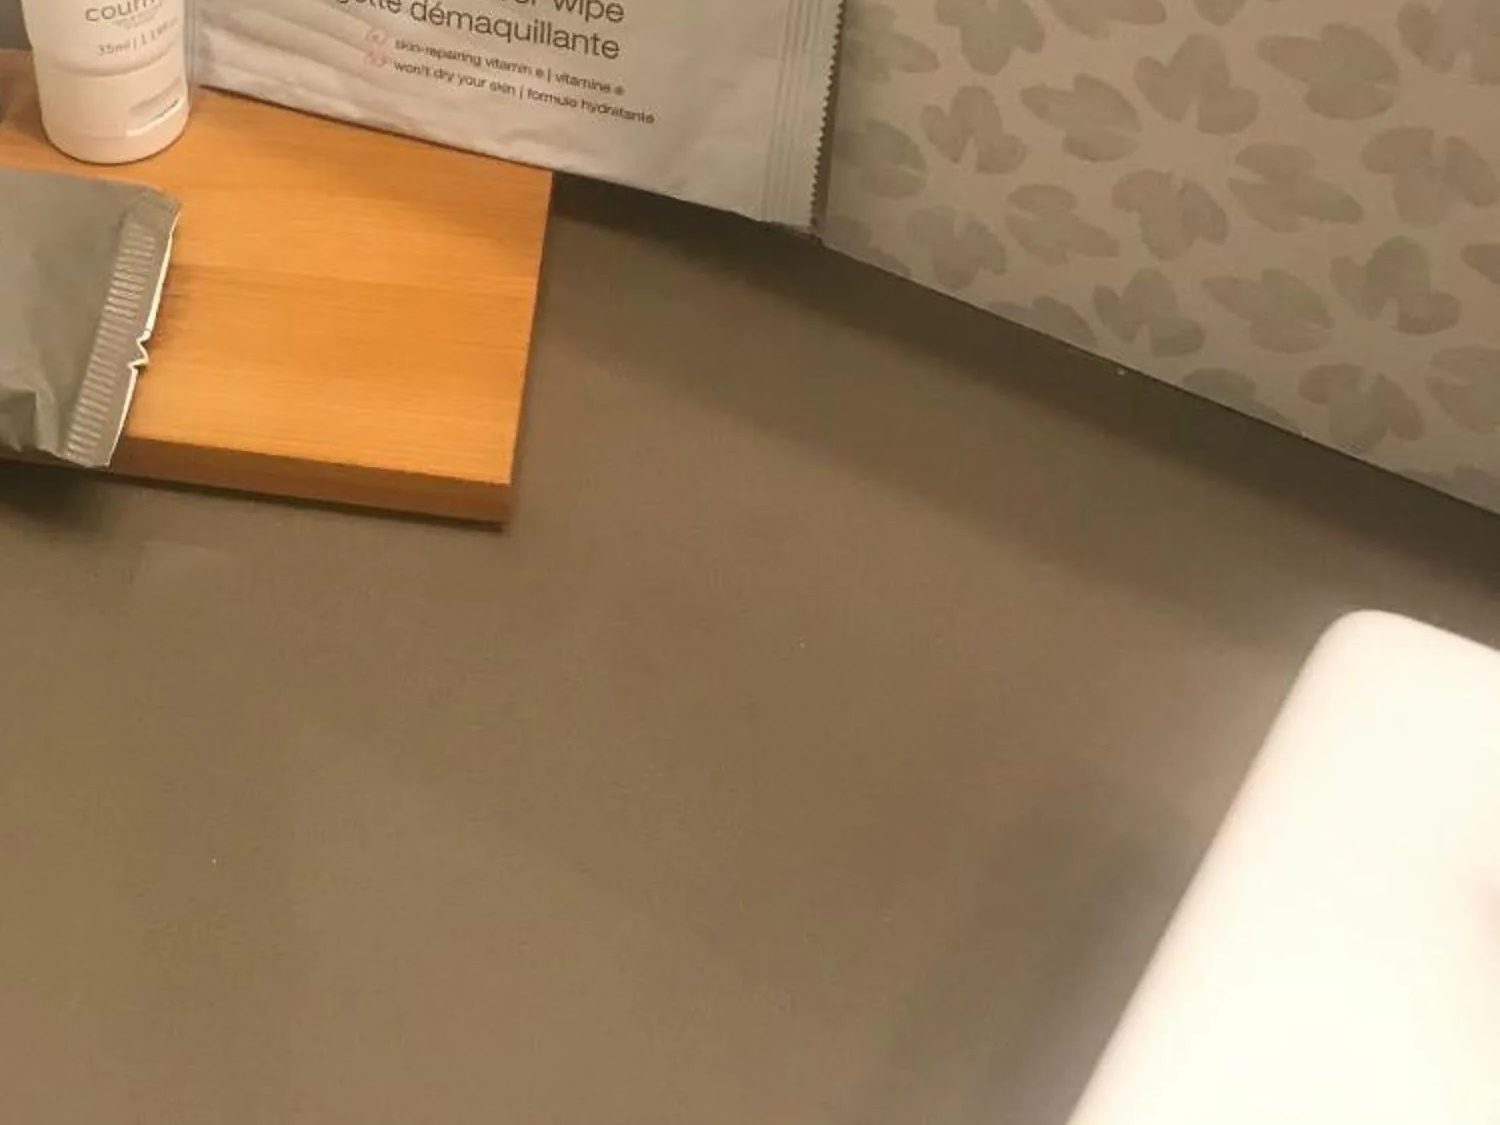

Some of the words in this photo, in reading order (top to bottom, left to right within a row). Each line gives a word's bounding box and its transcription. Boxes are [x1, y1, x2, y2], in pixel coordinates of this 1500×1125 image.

[485, 57, 533, 76] vitamin
[457, 73, 487, 88] your
[581, 98, 656, 125] hydratante
